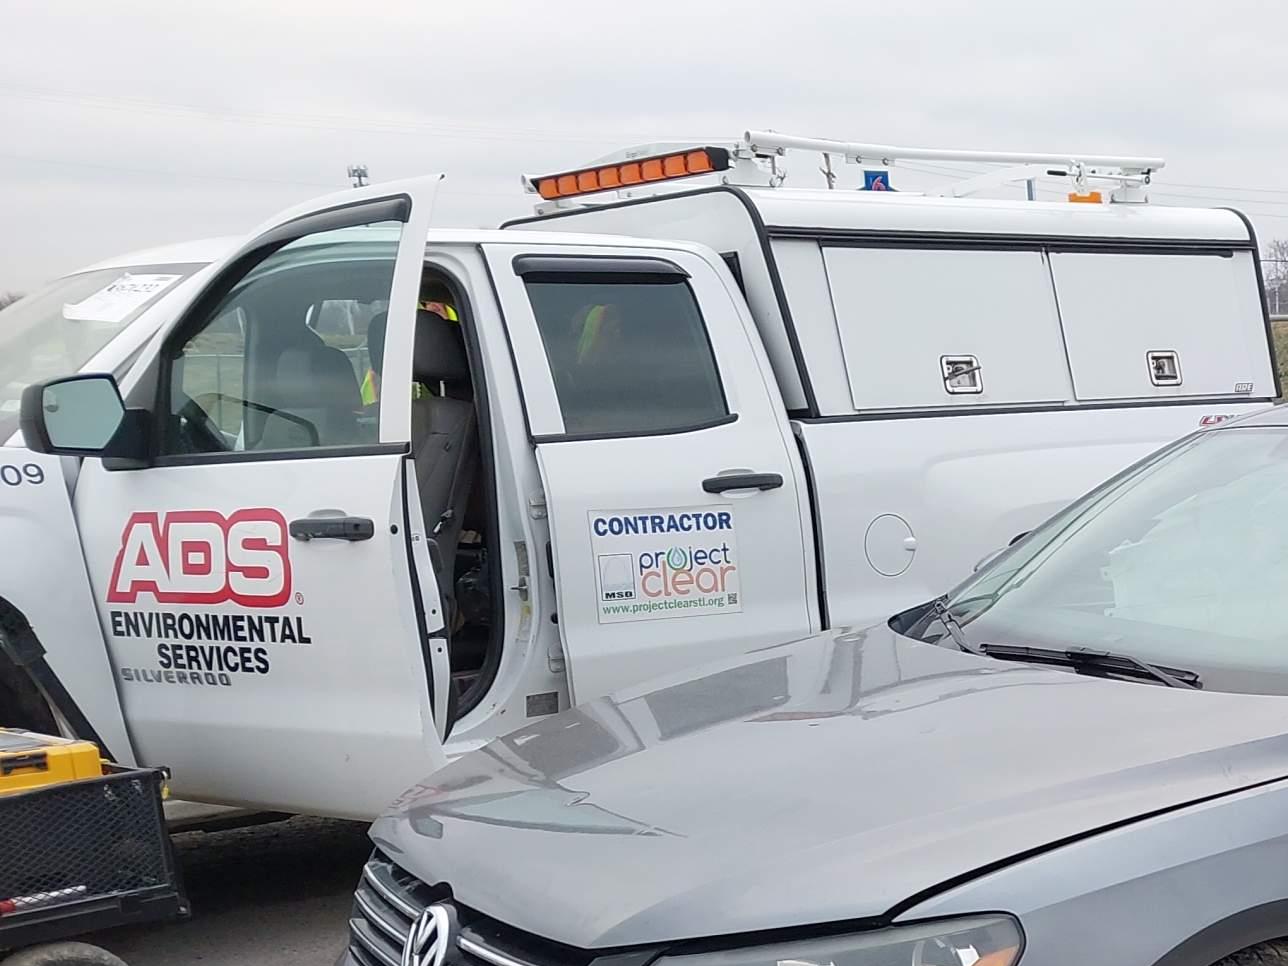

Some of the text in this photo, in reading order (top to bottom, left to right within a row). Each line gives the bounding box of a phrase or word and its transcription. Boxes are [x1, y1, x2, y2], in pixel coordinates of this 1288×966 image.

[0, 463, 45, 486] 09
[593, 512, 732, 537] CONTRACTOR
[107, 508, 292, 607] ADS
[639, 543, 731, 576] project
[641, 559, 736, 598] clear
[602, 597, 725, 614] www.projectclearstl.org
[110, 611, 312, 644] ENVIRONMENTAL
[158, 644, 270, 674] SERVICES
[121, 667, 233, 686] SILVERADO
